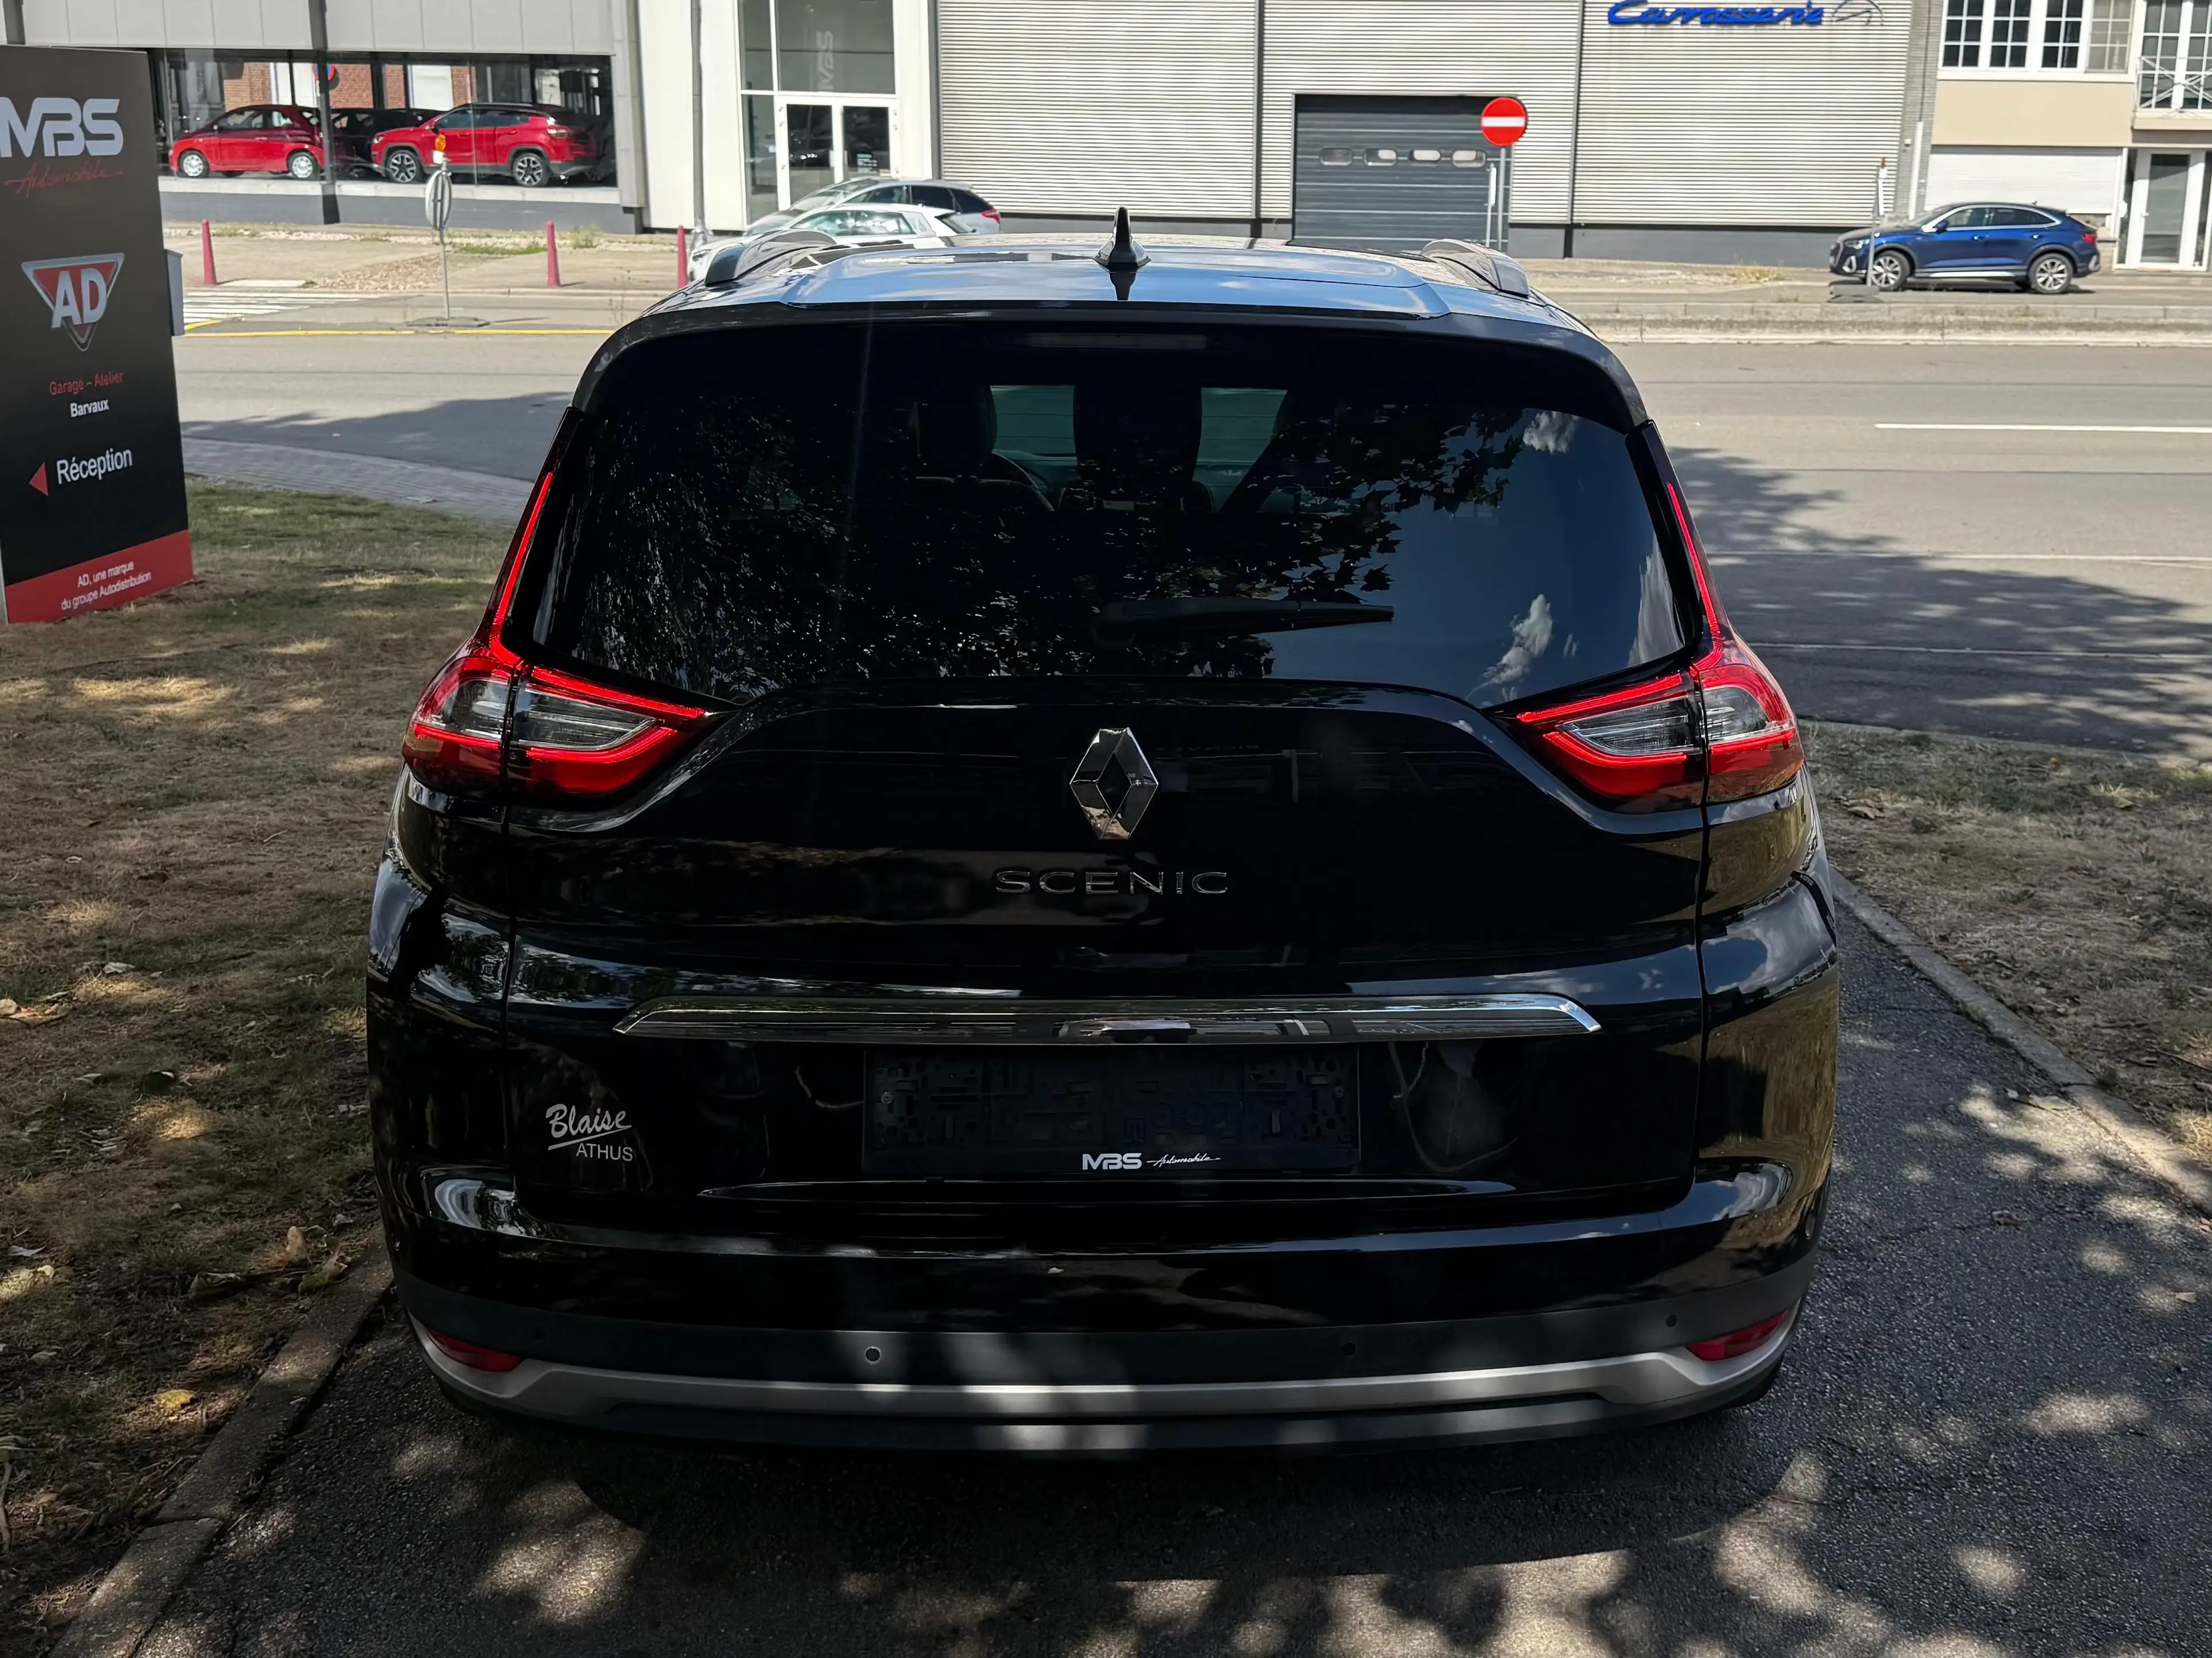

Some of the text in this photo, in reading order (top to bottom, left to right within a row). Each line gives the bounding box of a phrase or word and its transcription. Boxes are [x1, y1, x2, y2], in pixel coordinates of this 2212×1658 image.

[0, 97, 123, 157] MBS
[51, 268, 107, 328] AD
[50, 380, 84, 395] Garage
[94, 371, 123, 387] Atelier
[70, 399, 109, 418] Barvaux
[56, 447, 132, 484] Réception
[77, 561, 134, 588] AD, une marque
[61, 572, 151, 610] du groupe Autodistribution
[995, 871, 1229, 894] SCENIC
[546, 1103, 632, 1138] Blaise
[576, 1143, 633, 1162] ATHUS
[1082, 1152, 1221, 1170] MBS Automobile
